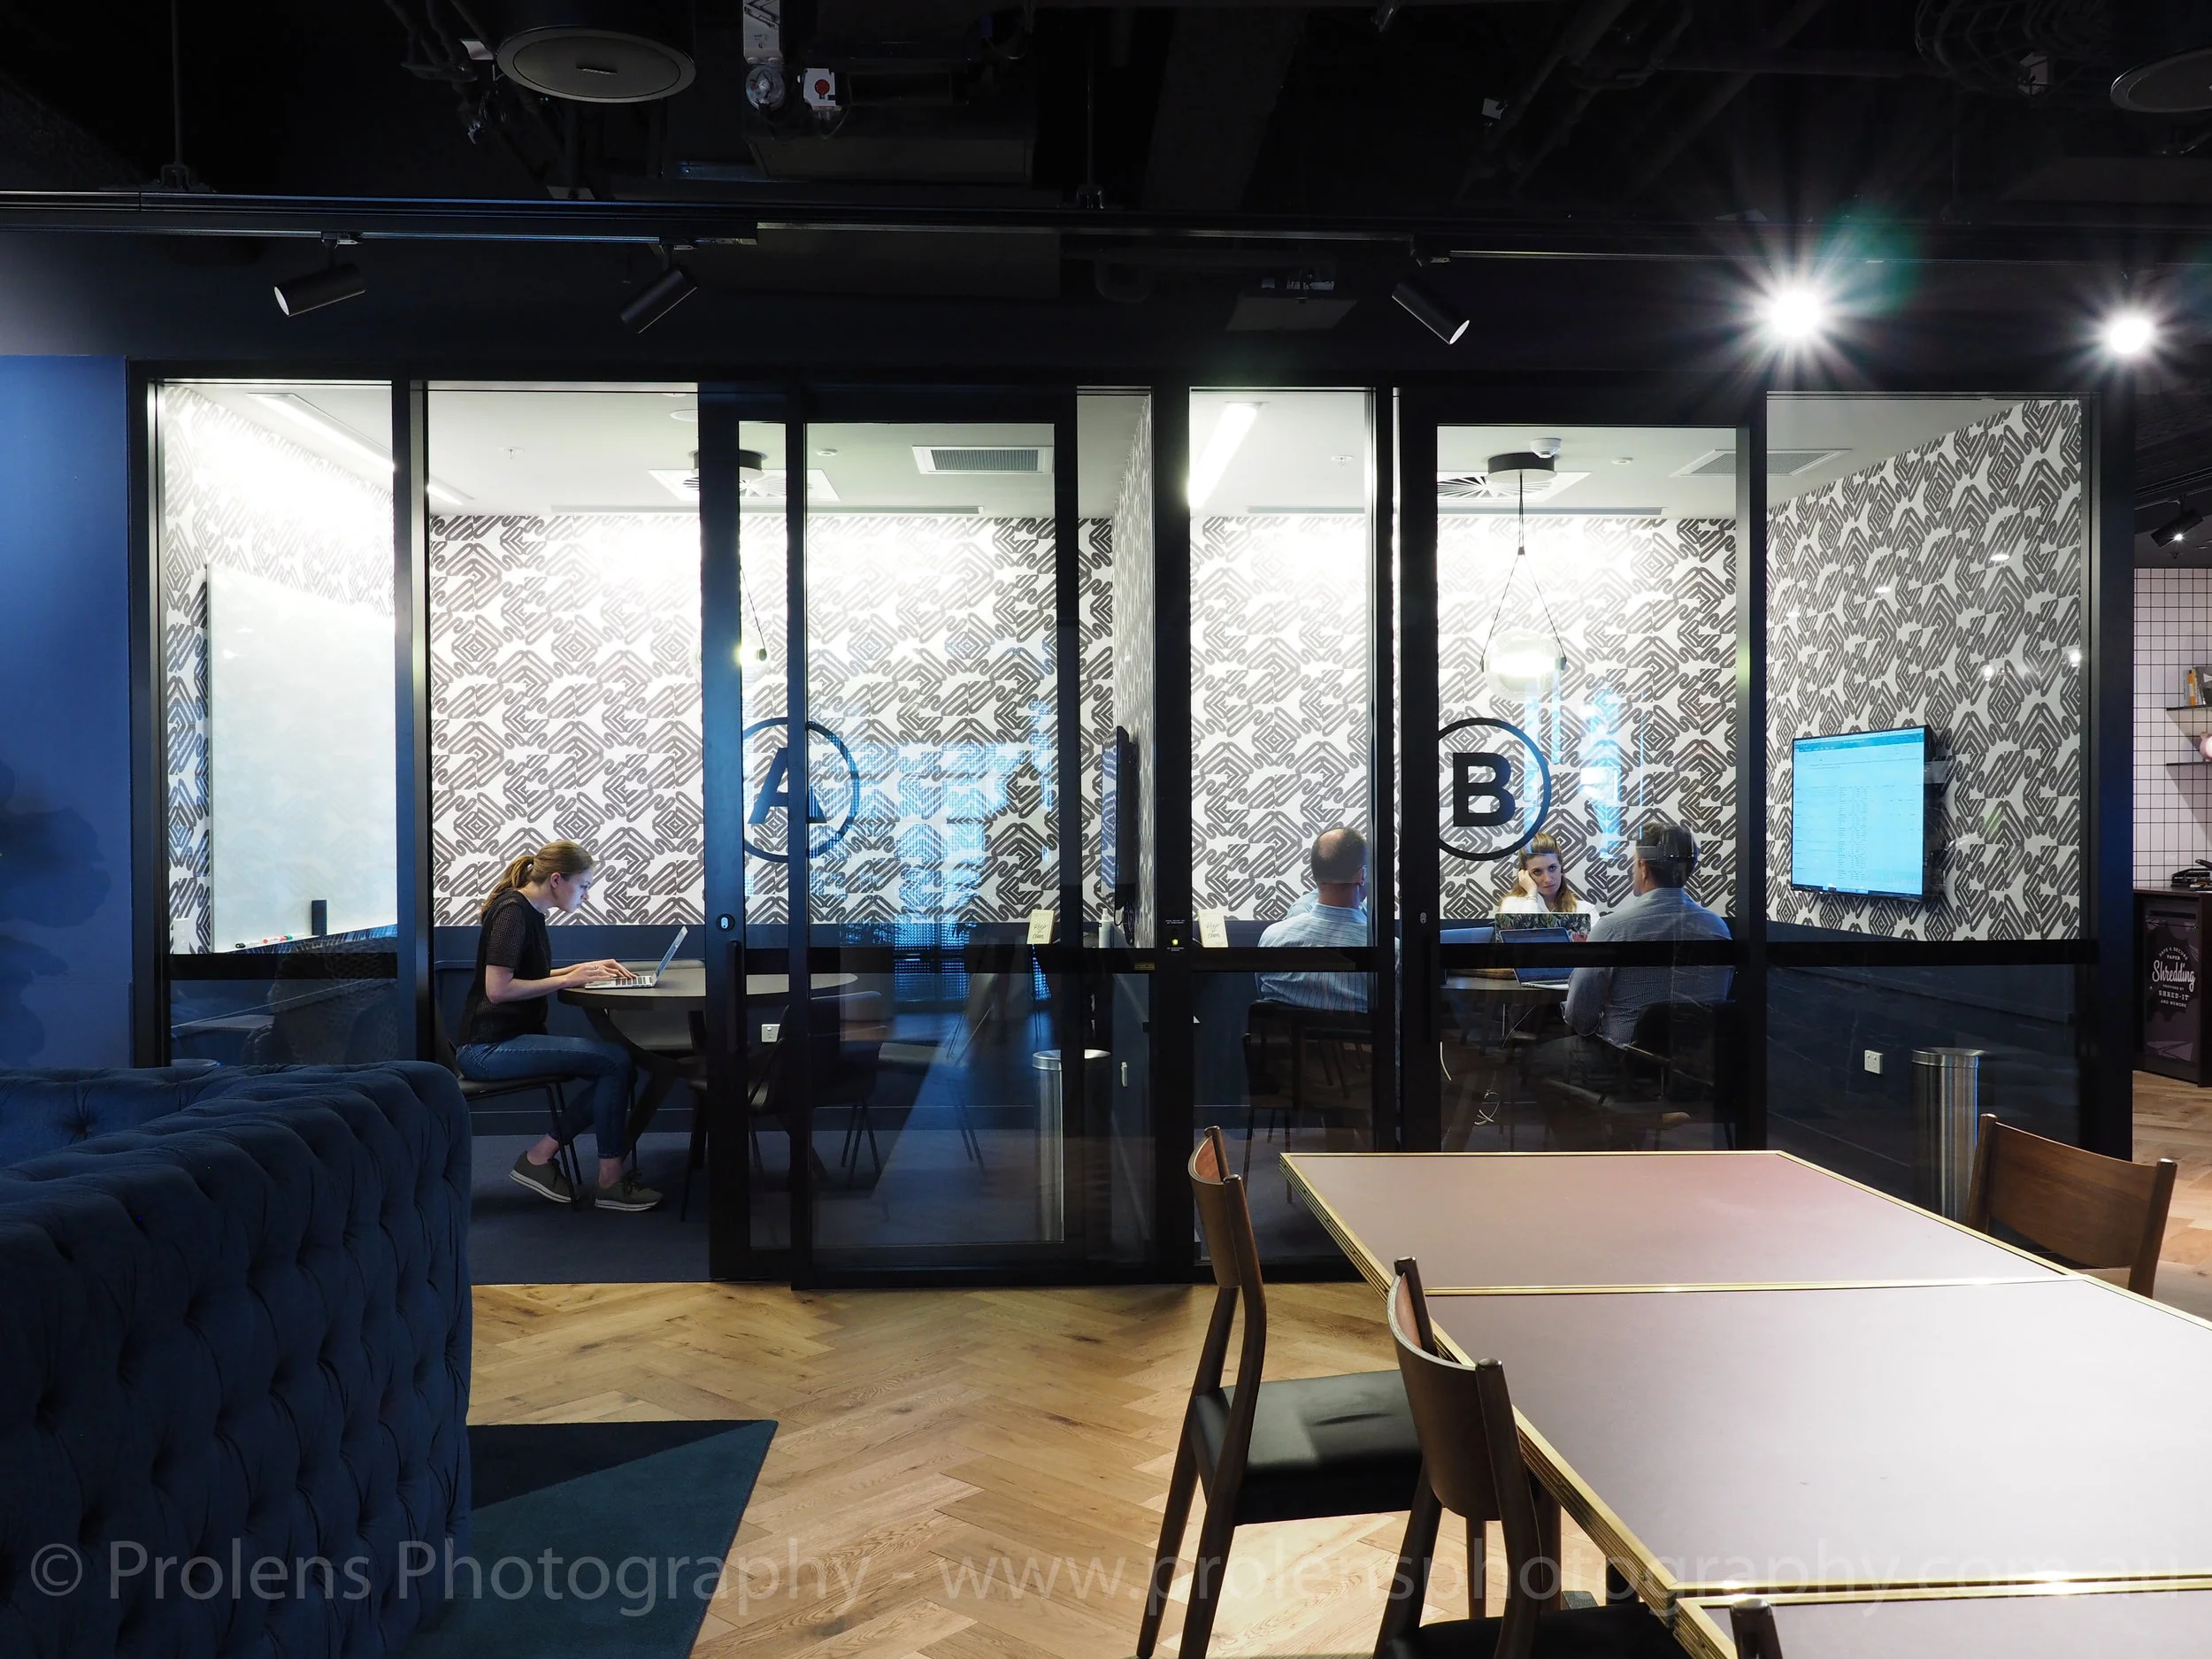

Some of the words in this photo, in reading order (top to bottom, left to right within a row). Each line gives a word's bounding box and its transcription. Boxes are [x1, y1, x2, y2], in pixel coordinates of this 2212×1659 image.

[748, 748, 827, 824] A
[1453, 752, 1516, 826] B
[2152, 960, 2196, 992] Shredding
